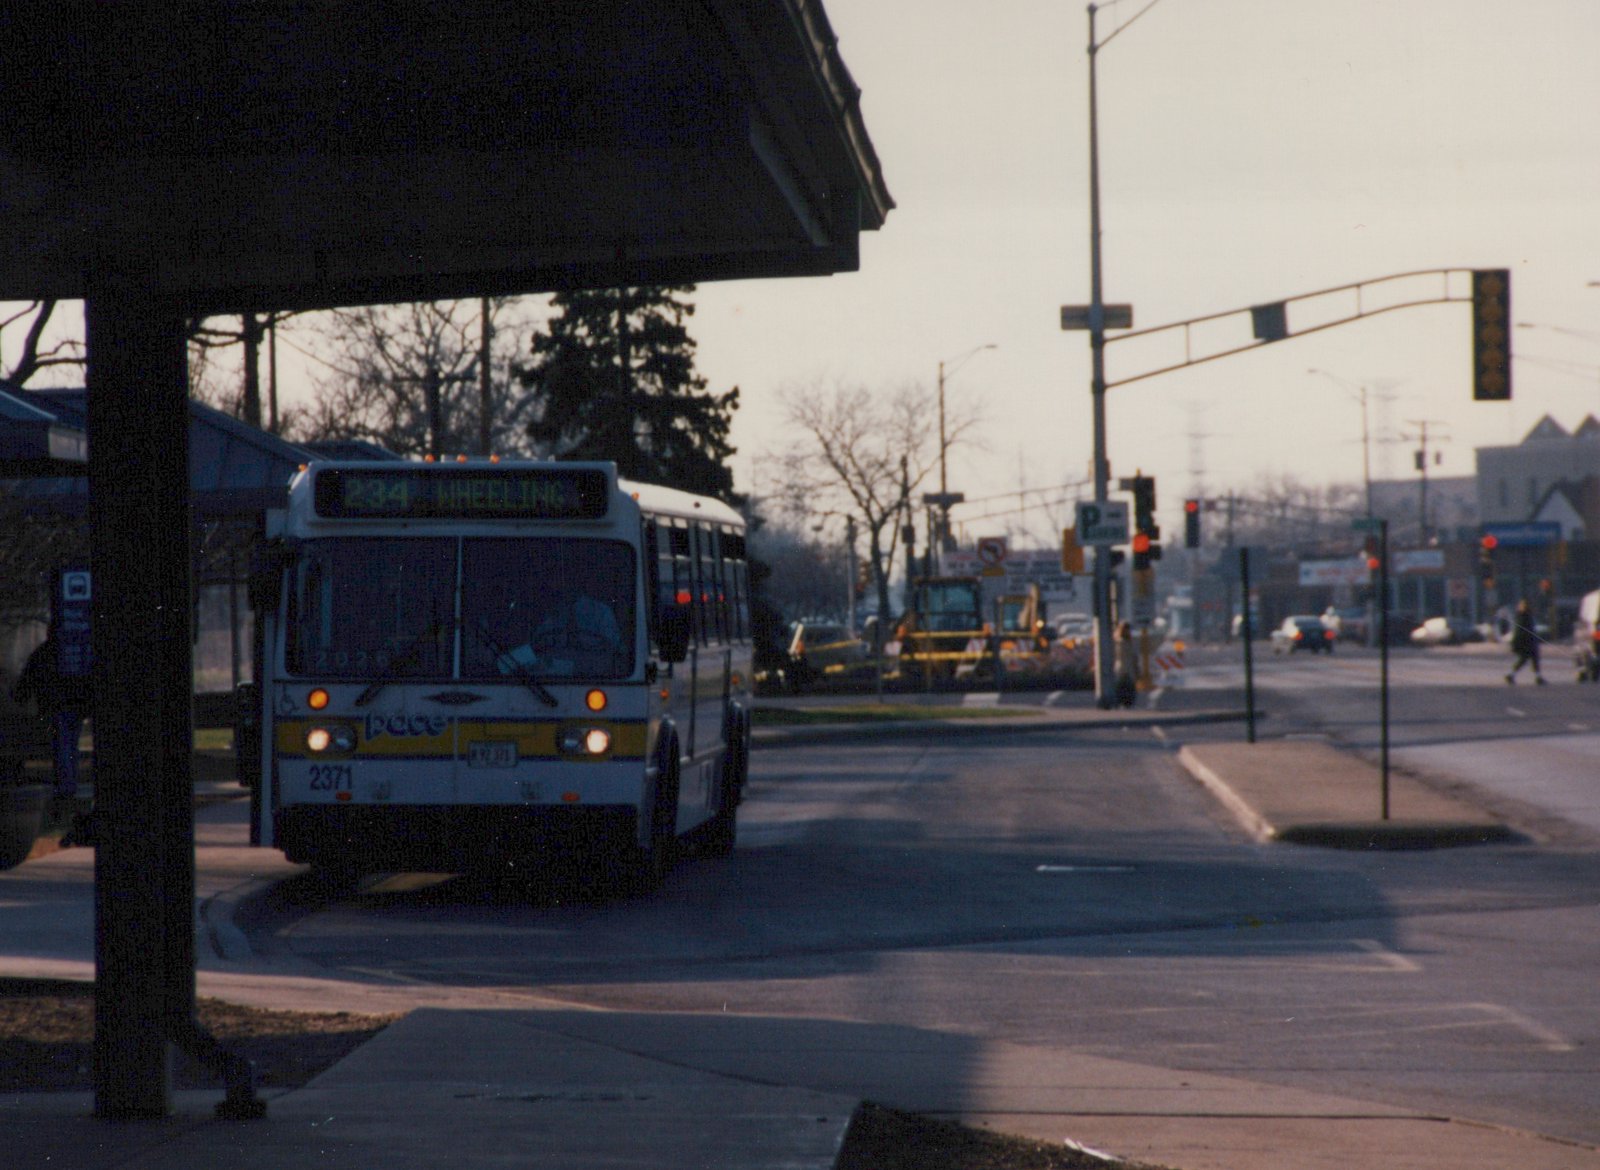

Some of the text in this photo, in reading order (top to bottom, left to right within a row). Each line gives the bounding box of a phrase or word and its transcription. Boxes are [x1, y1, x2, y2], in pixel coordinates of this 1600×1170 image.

[345, 478, 565, 507] 234 WHEELING
[365, 712, 448, 740] pace
[309, 764, 353, 790] 2371
